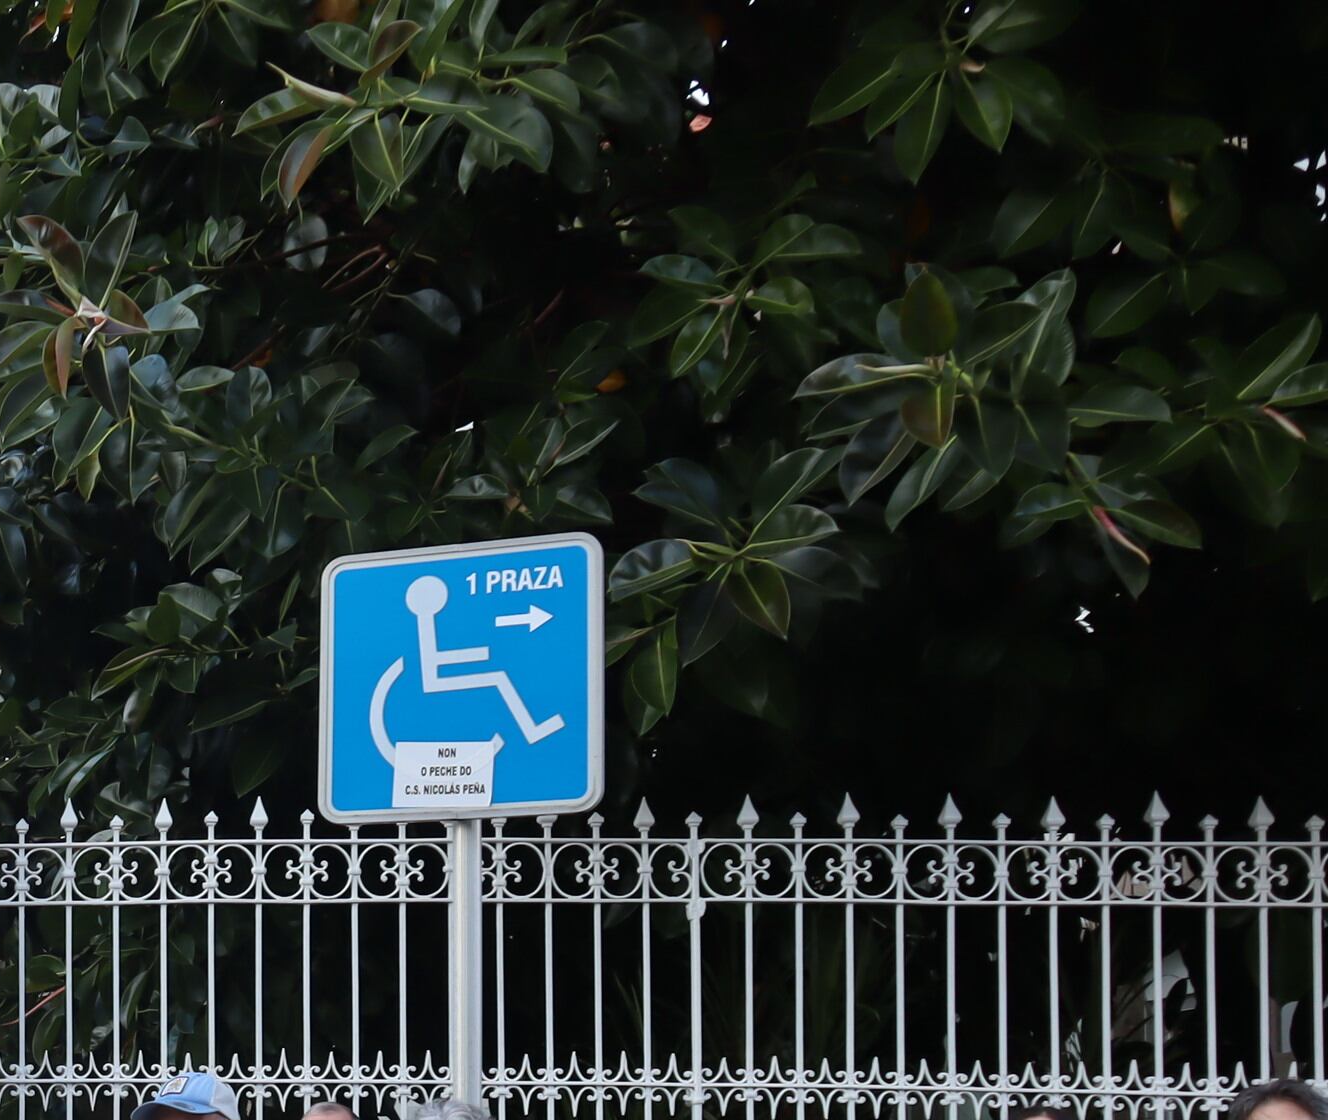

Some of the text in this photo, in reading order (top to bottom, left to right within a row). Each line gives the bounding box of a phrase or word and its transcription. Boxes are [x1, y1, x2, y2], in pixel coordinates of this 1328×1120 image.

[466, 565, 564, 595] 1 PRAZA
[438, 748, 456, 758] NON
[420, 766, 472, 777] O PECHE DO
[405, 782, 486, 796] C.S. NICOLÁS PEÑA
